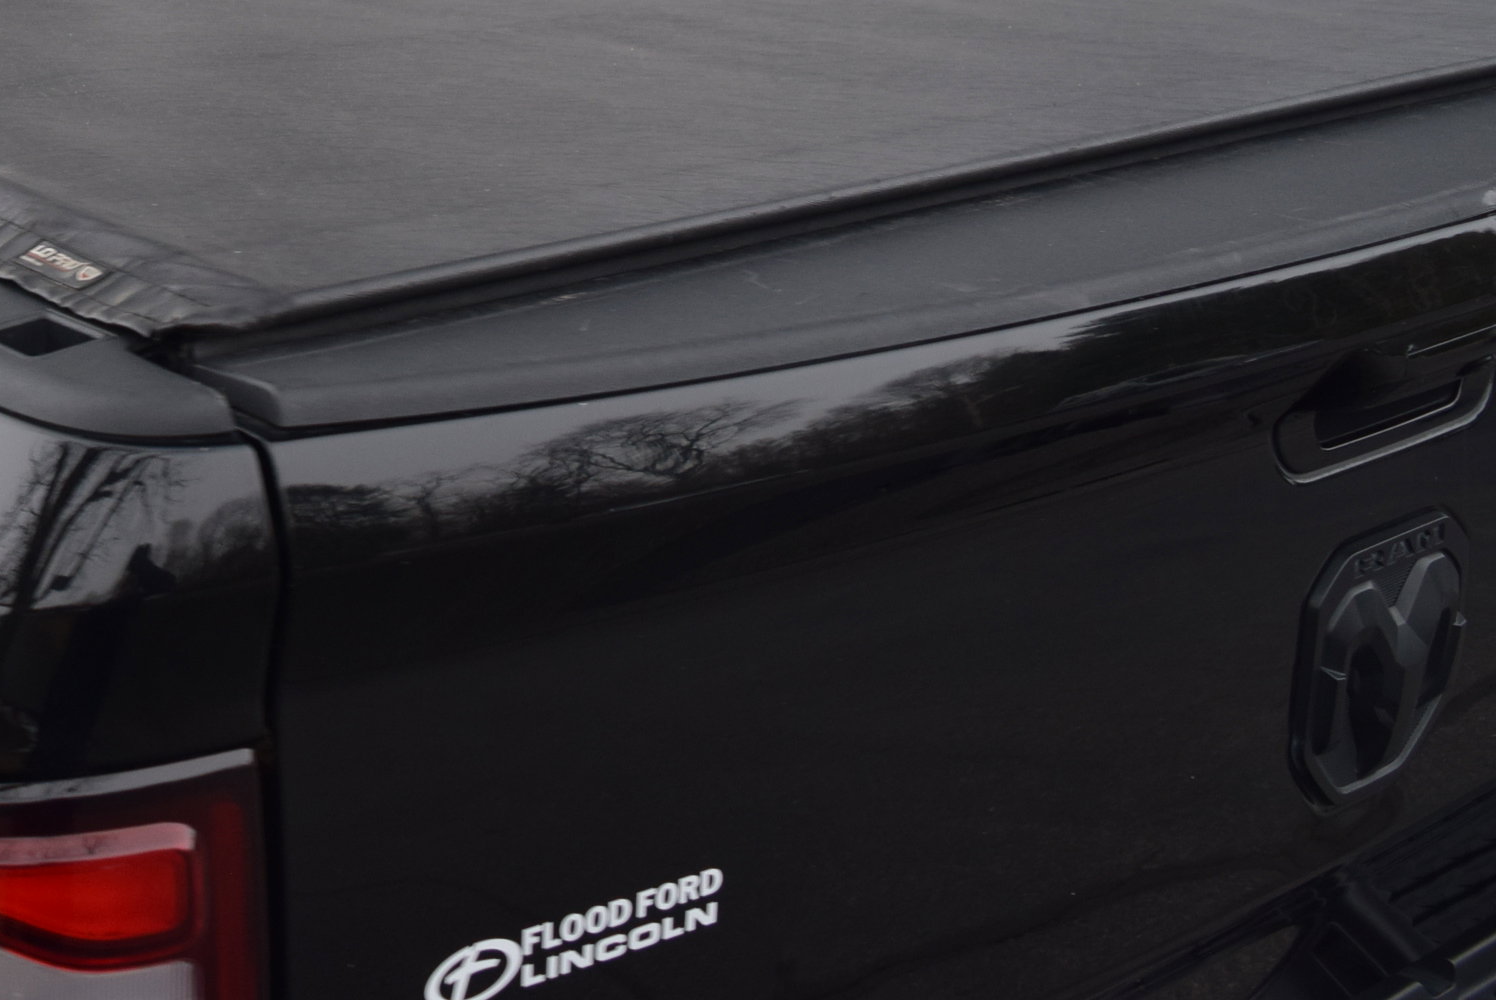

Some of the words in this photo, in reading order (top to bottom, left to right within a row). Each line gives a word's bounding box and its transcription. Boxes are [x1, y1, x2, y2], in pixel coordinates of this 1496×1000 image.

[1354, 524, 1446, 577] RAM
[520, 902, 719, 988] LINCOLN
[521, 898, 633, 956] FLOOD
[635, 868, 724, 918] FORD
